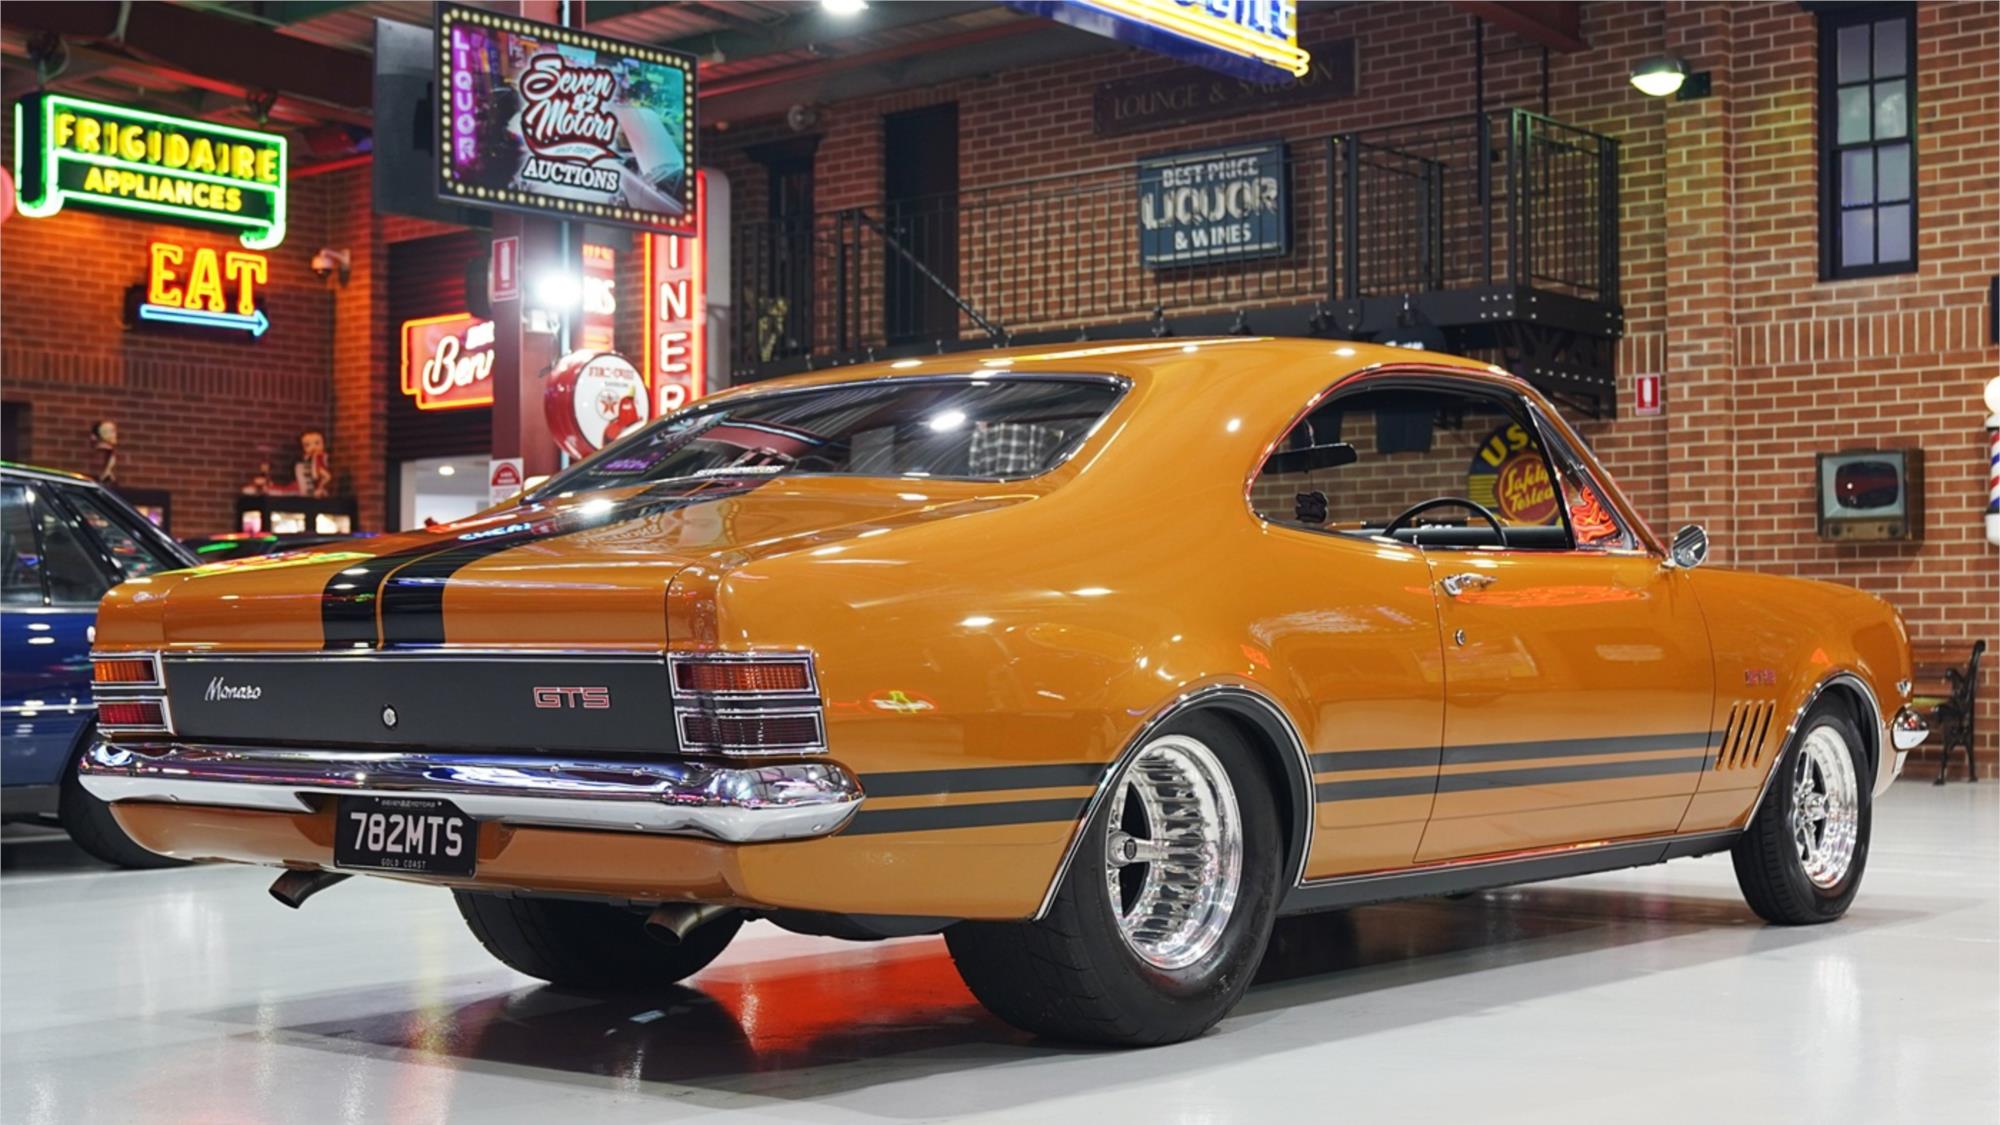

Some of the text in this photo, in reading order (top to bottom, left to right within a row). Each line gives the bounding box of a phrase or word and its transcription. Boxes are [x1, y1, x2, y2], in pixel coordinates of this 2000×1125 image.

[453, 29, 476, 161] LIQUOR
[523, 58, 613, 100] Seven
[526, 99, 614, 140] Motors
[572, 93, 598, 113] 82
[1114, 84, 1200, 120] LOUNGE
[1209, 81, 1226, 104] &
[55, 112, 278, 183] FRIGIDAIRE
[84, 167, 242, 212] APPLIANCES
[523, 158, 618, 191] AUCTIONS
[1163, 157, 1259, 188] BEST PRICE
[1142, 177, 1278, 230] LIQUOR
[1175, 223, 1252, 250] & WINES
[150, 243, 267, 315] EAT
[1481, 422, 1537, 467] US
[204, 677, 261, 701] Monaro
[533, 686, 609, 708] GTS
[350, 812, 464, 857] 782MTS
[381, 858, 427, 869] GOLD COAST
